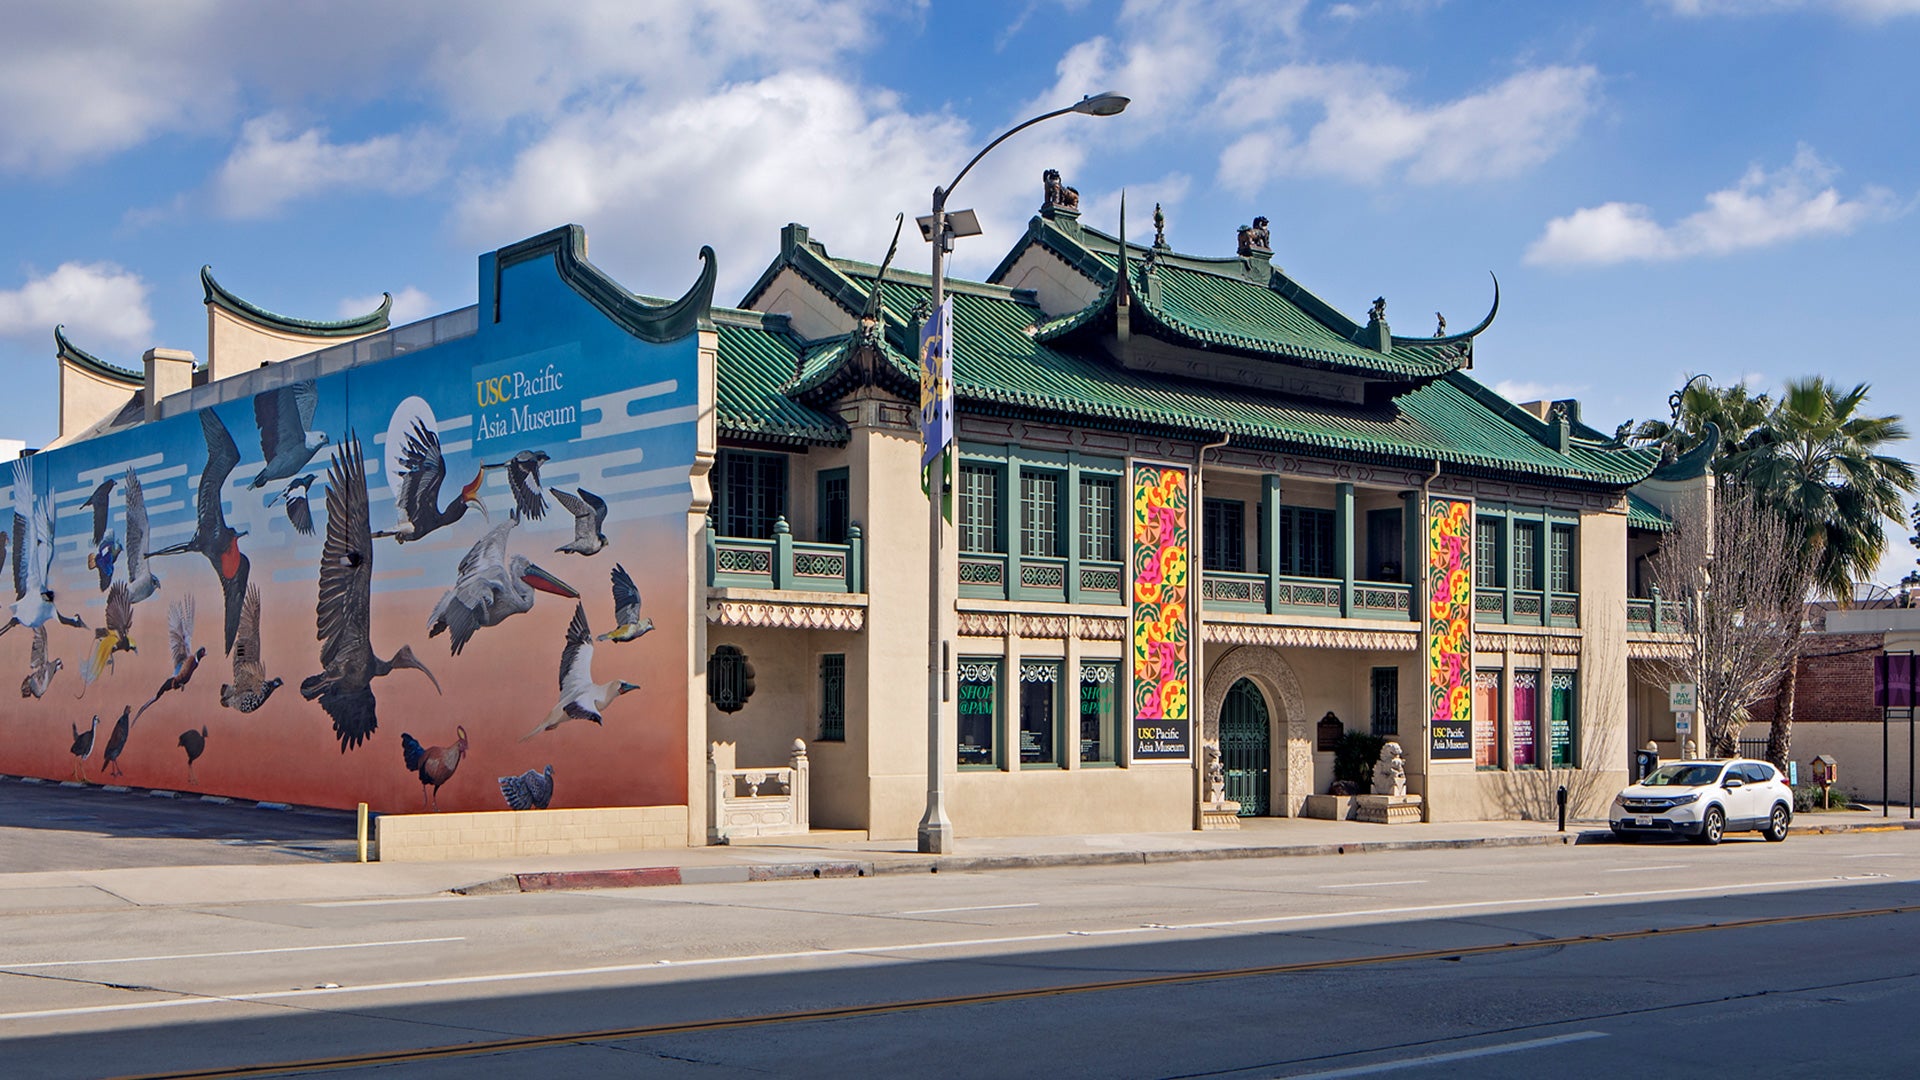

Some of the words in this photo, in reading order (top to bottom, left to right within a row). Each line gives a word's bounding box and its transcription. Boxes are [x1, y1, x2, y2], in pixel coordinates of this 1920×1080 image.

[476, 375, 512, 408] USC
[513, 364, 563, 399] Pacific
[477, 413, 507, 441] Asia
[510, 404, 576, 432] Museum
[960, 685, 995, 699] SHOP
[1137, 728, 1155, 739] USC
[1156, 728, 1179, 739] Pacific
[1433, 727, 1446, 738] USC
[1447, 727, 1465, 738] Pacific
[1137, 741, 1153, 752] Asia
[1155, 741, 1185, 752] Museum
[1433, 739, 1446, 750] Asia
[1446, 739, 1469, 749] Museum
